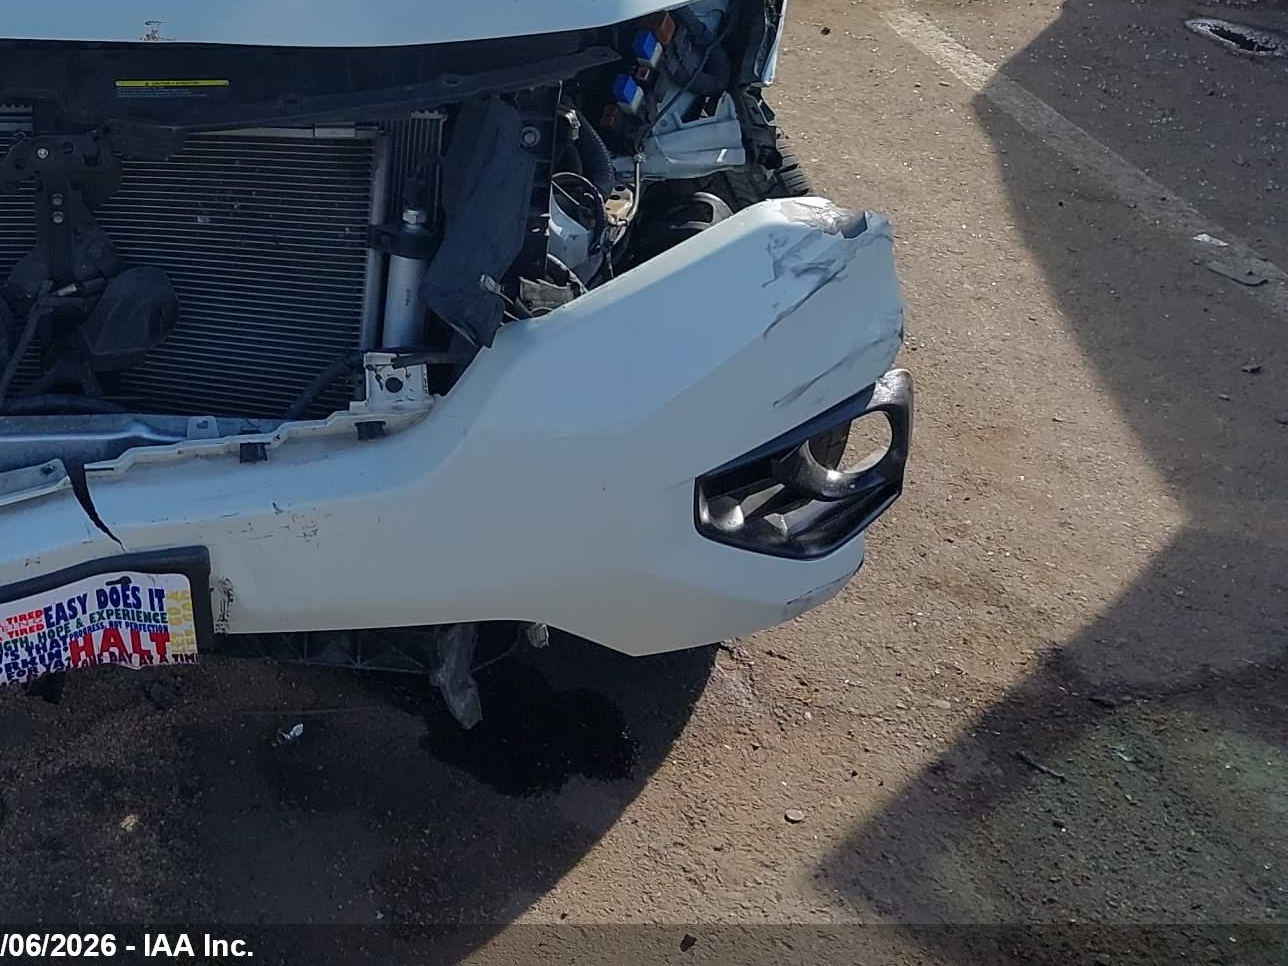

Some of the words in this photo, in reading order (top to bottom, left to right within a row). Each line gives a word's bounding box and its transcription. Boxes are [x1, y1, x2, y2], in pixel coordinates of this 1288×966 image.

[6, 610, 44, 624] TIRED
[43, 593, 88, 629] EASY
[95, 584, 142, 610] DOES
[148, 588, 166, 612] IT
[7, 624, 45, 638] TIRED
[37, 622, 71, 643] HOPE
[75, 618, 84, 629] &
[89, 609, 168, 624] EXPERIENCE
[25, 634, 68, 657] THAT
[68, 626, 171, 668] HALT
[6, 667, 39, 682] FOR
